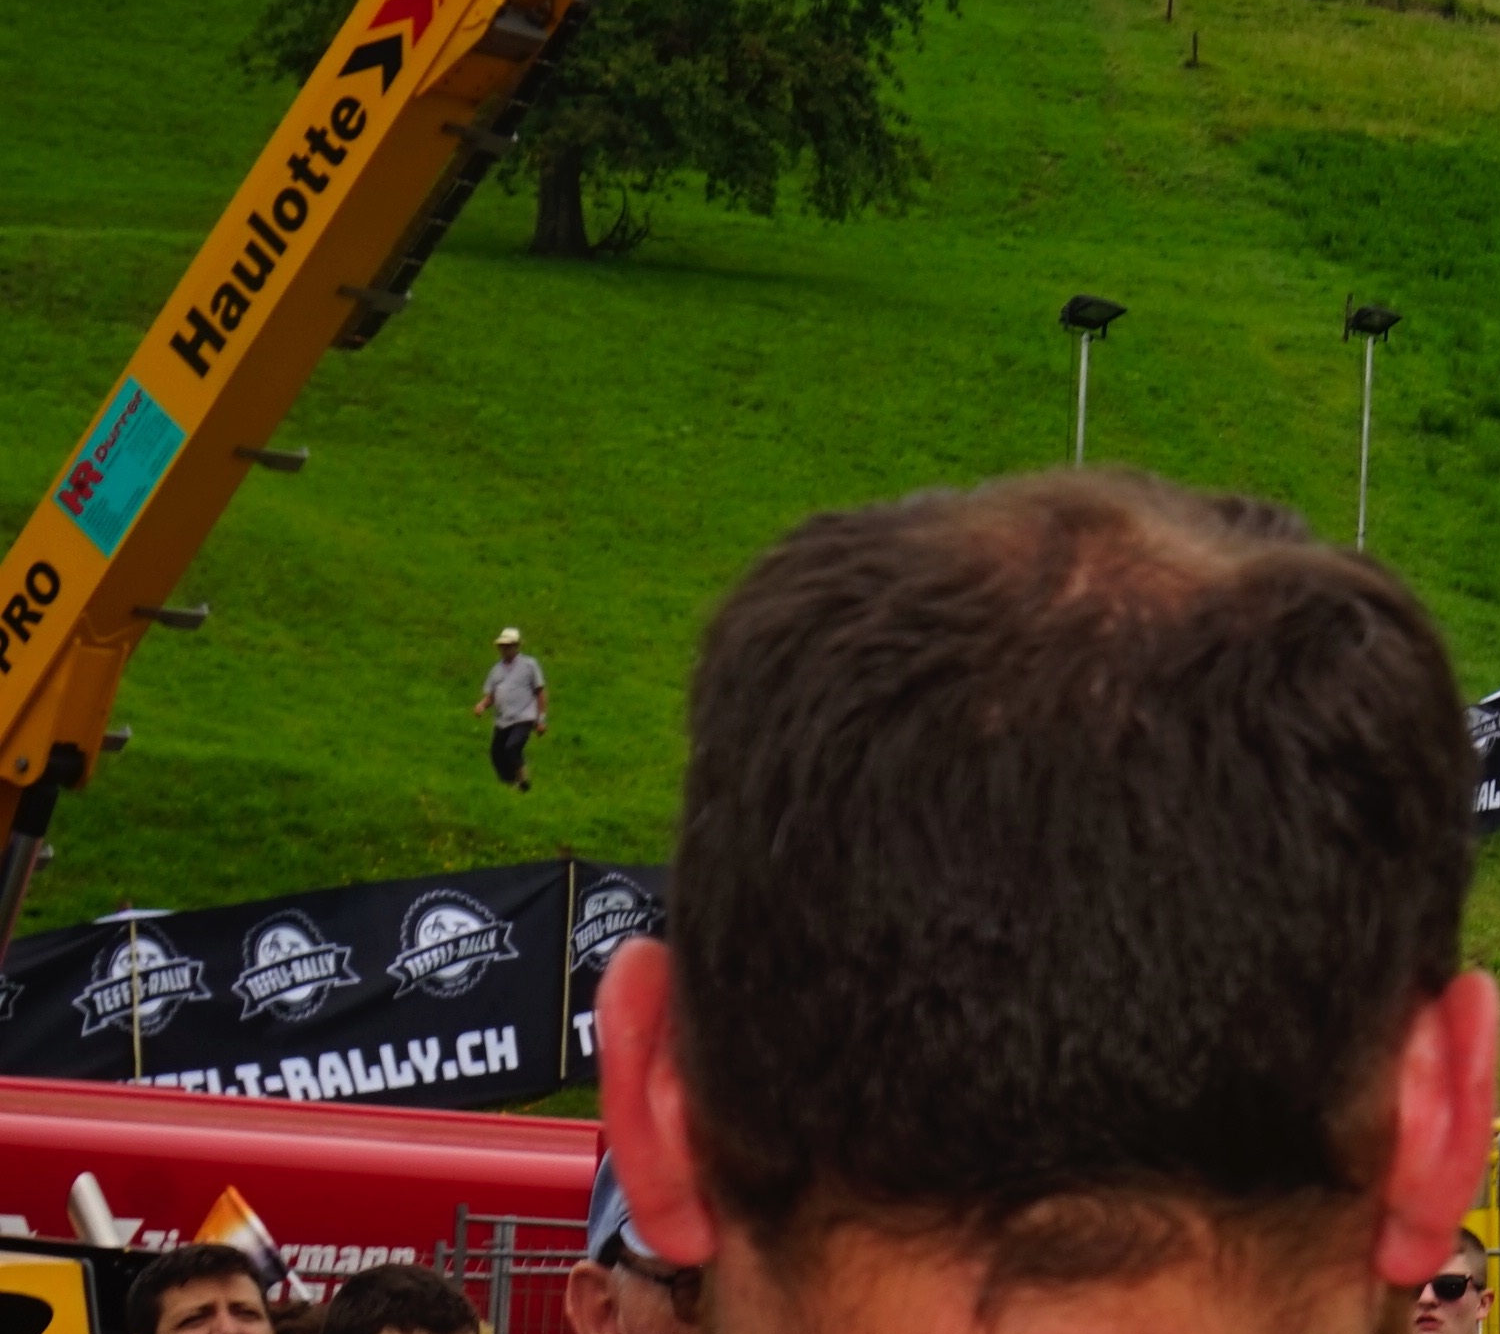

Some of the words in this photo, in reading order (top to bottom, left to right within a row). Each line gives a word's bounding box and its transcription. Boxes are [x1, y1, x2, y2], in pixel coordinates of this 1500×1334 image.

[169, 93, 367, 379] Haulotte
[246, 951, 337, 1001] TEFFLI-RALLY
[403, 928, 499, 981] TEFFLI-RALLY
[93, 965, 192, 1017] TEFFI-RALLY
